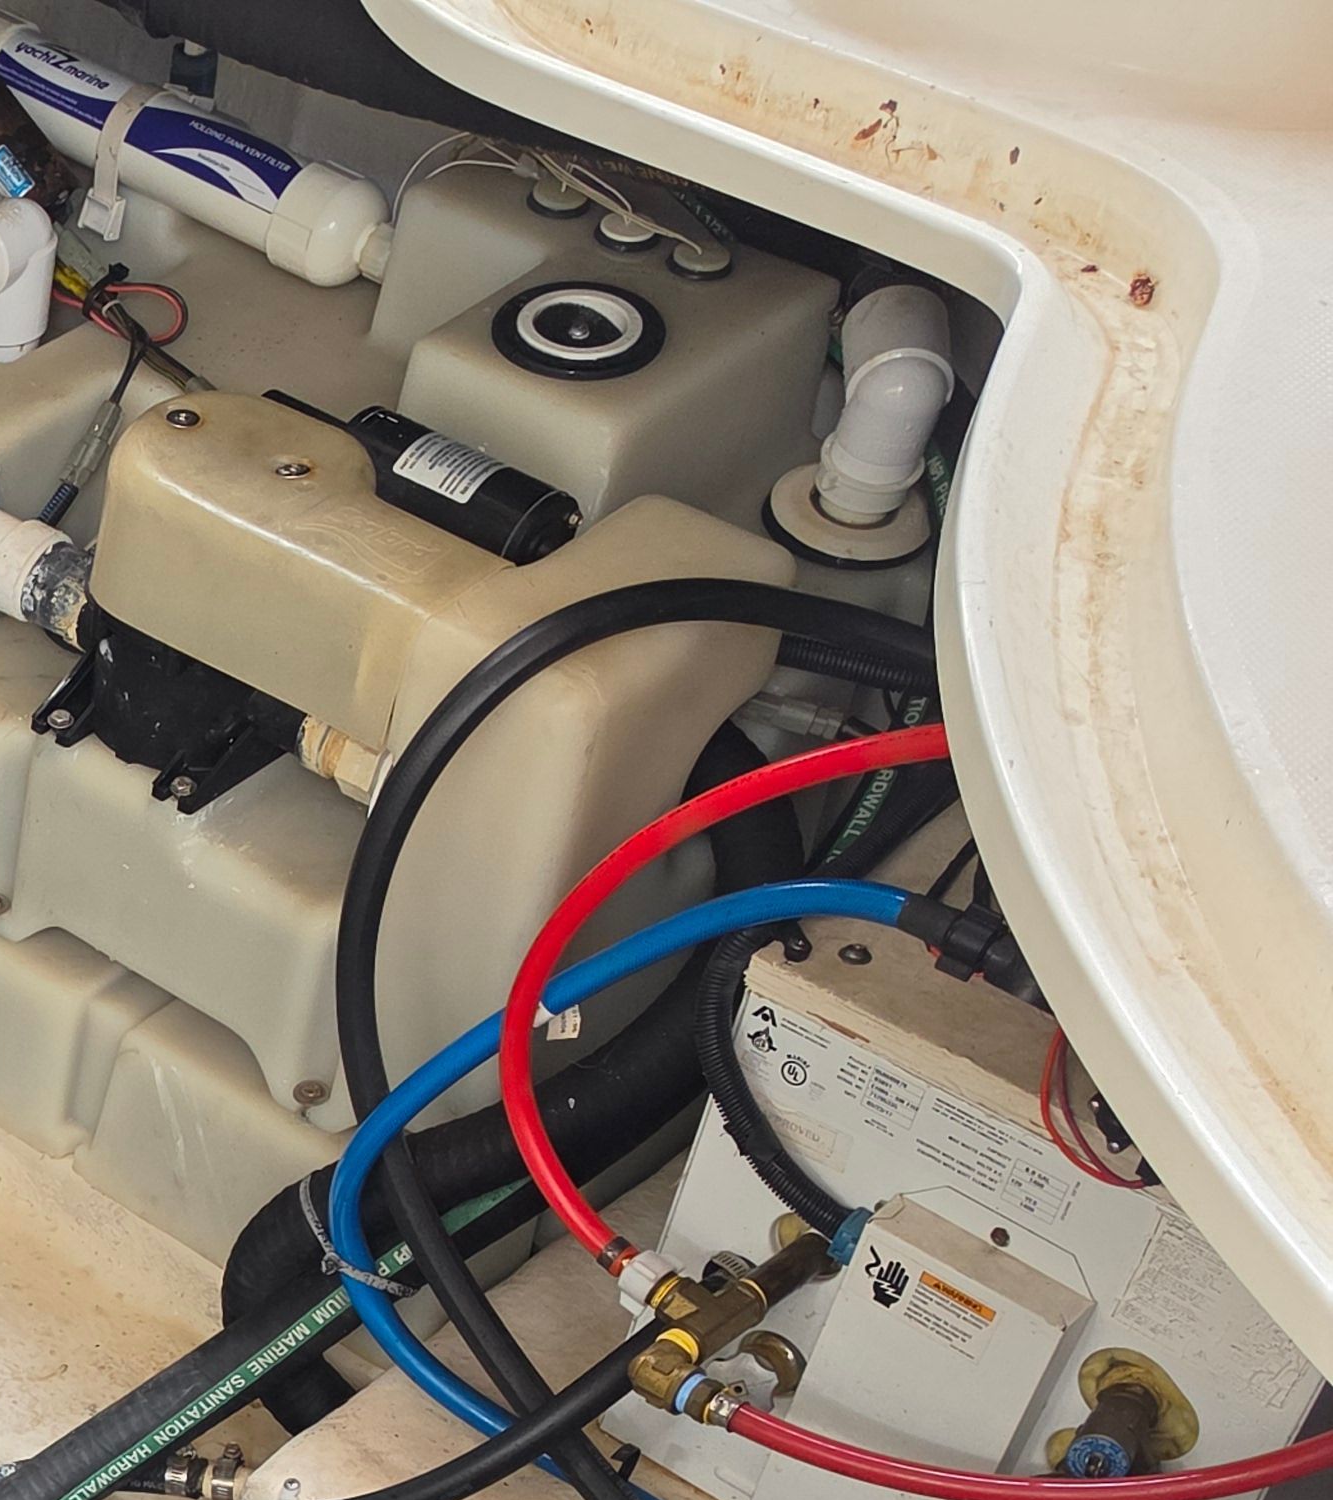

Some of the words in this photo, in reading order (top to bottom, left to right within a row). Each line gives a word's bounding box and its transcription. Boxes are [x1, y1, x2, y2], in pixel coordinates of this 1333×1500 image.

[187, 118, 226, 142] HOLDING
[223, 134, 247, 152] TANK
[244, 144, 267, 161] VENT
[263, 154, 293, 174] FILTER
[241, 1319, 315, 1377] MARINE
[148, 1372, 248, 1446] SANITATION
